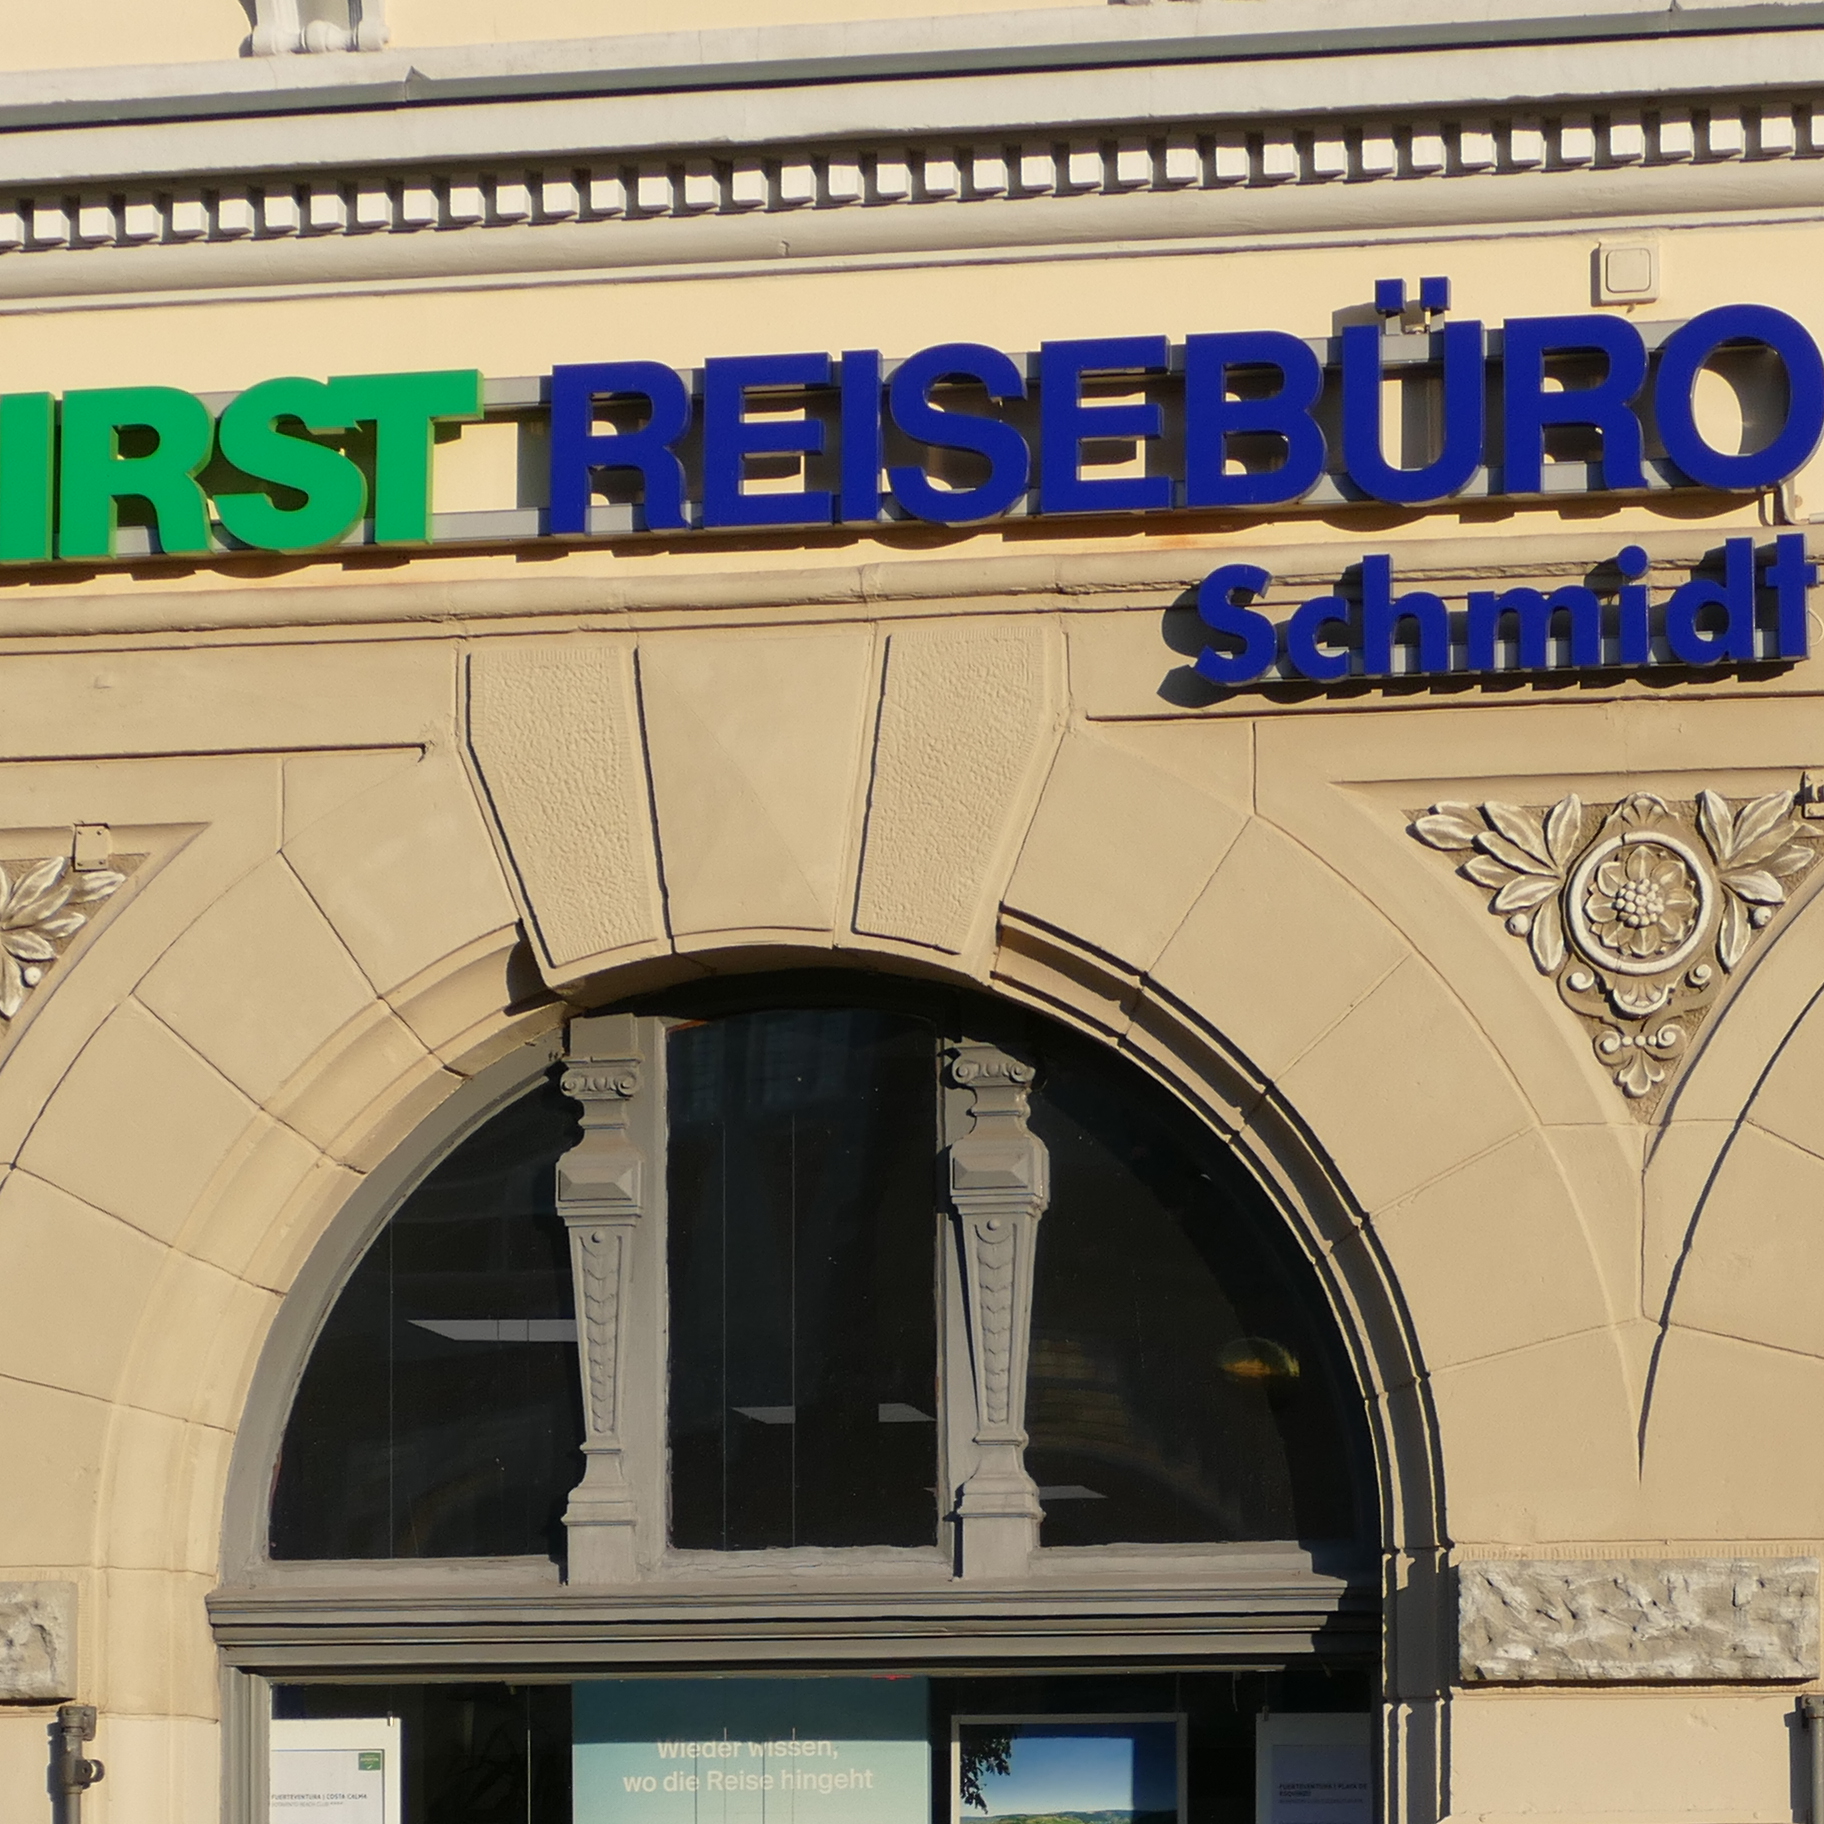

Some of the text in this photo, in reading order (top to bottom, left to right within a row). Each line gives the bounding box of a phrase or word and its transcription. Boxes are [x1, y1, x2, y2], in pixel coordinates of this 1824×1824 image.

[1193, 534, 1818, 689] Schmidt
[657, 1739, 838, 1759] Wieder wissen,
[624, 1768, 873, 1794] wo die Reise hingeht
